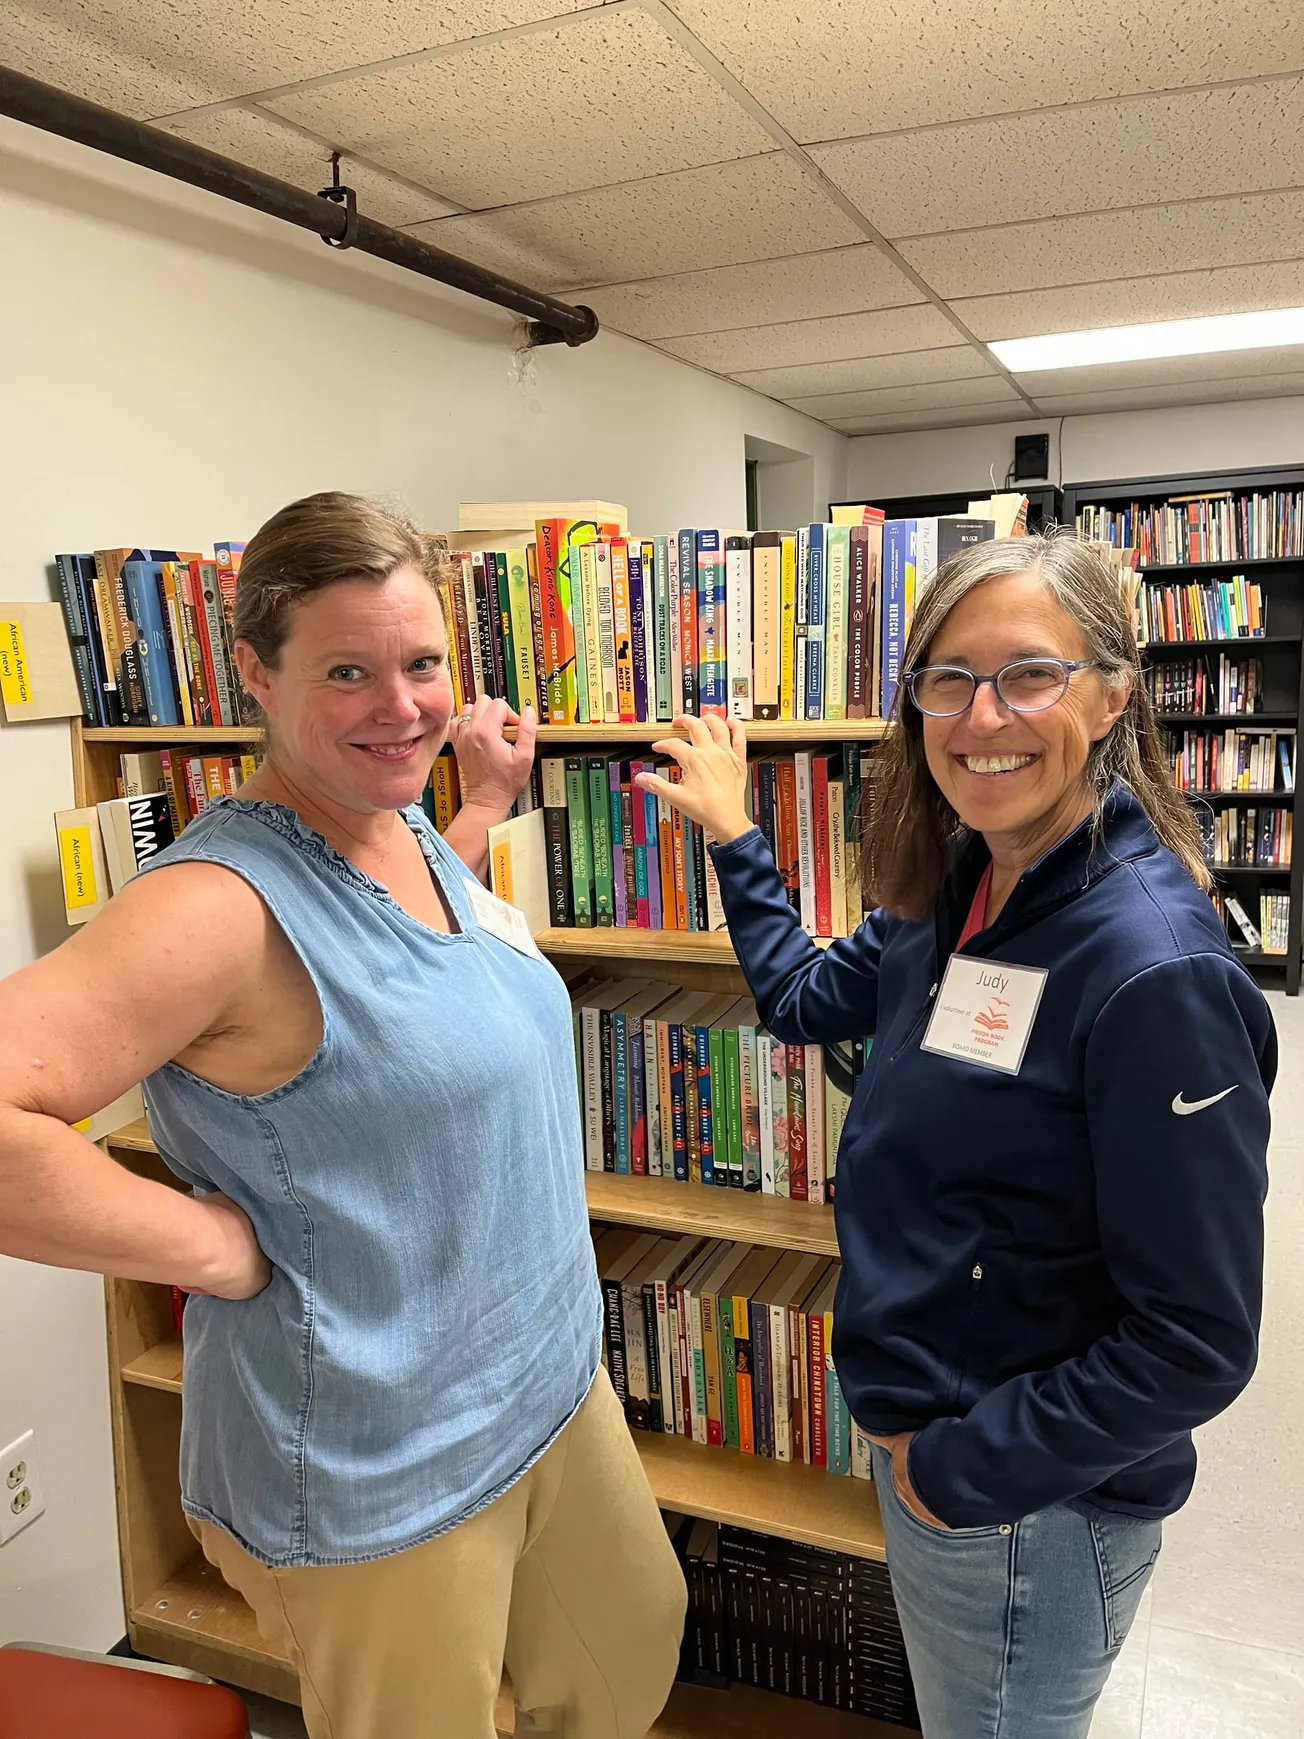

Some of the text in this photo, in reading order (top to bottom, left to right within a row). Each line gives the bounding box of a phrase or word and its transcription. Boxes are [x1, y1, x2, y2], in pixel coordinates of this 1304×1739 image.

[570, 550, 579, 578] WALKER
[612, 554, 625, 580] HELL
[855, 548, 863, 570] ALICE
[669, 560, 679, 616] The Color Purple
[705, 570, 715, 602] SHADOW
[832, 556, 841, 597] HOUSE
[855, 573, 863, 604] WALKER
[583, 560, 593, 627] Lesson Before Dying
[813, 593, 819, 604] MY
[114, 578, 137, 680] FREDERICK DOUGLASS
[502, 612, 510, 635] SULA
[598, 586, 614, 669] BELOVED TONI MORRISON
[615, 607, 628, 635] BOOK
[682, 536, 693, 692] REVIVAL SEASON MONICA WEST
[705, 604, 715, 623] KING
[832, 602, 841, 630] GIRL
[207, 606, 228, 704] PIECING ME TOGETHER
[470, 621, 482, 681] LINDEN HILLS
[483, 625, 493, 675] MORRISON
[532, 582, 543, 617] coming
[539, 667, 549, 707] america
[635, 597, 646, 682] TONI MORRISON
[659, 643, 666, 651] ON
[706, 639, 716, 662] MAAZA
[887, 603, 899, 682] REBECCA, NOT BECKY
[0, 650, 12, 677] (new)
[9, 623, 28, 702] African American
[519, 647, 529, 681] FAUSET
[549, 625, 563, 705] James McBride
[587, 638, 598, 687] GAINES
[854, 644, 862, 669] COLOR
[617, 667, 625, 691] MOTT
[706, 664, 716, 697] MENGISTE
[853, 671, 861, 698] PURPLE
[193, 772, 203, 791] The
[210, 766, 220, 791] THE
[436, 766, 446, 796] HOUSE
[831, 786, 839, 803] Paton
[439, 800, 447, 812] OF
[783, 766, 793, 836] Half Yellow Sun
[799, 797, 807, 815] JOLLOF
[169, 806, 181, 833] MADNESS
[800, 816, 808, 828] RICE
[800, 829, 808, 838] AND
[576, 819, 586, 879] BURIED BENEATH
[598, 817, 607, 877] BURIED BENEATH
[637, 847, 645, 870] ARROW
[800, 839, 809, 855] OTHER
[71, 838, 86, 897] African (new)
[499, 855, 507, 891] African
[552, 823, 565, 911] THE POWER OF ONE
[675, 837, 684, 892] MY STORY
[707, 864, 717, 896] ADICHIE
[801, 856, 810, 888] REVOLUTIONS
[833, 854, 841, 879] Country
[976, 970, 1010, 993] Judy
[602, 1025, 611, 1052] Magical
[645, 1024, 654, 1064] HA JIN
[742, 1033, 750, 1051] THE
[952, 1042, 993, 1059] BOARD MEMBER
[971, 1028, 1005, 1041] PRISON BOOK
[974, 1037, 999, 1047] PROGRAM
[587, 1032, 595, 1071] INVISIBLE
[615, 1019, 626, 1090] ASYMMETRY
[630, 1039, 641, 1069] Jasmine
[588, 1071, 596, 1103] VALLEY
[602, 1054, 611, 1091] Language
[671, 1032, 682, 1130] EDINBURGH ALEXANDER
[699, 1034, 708, 1134] EDINBURGH ALEXANDER
[743, 1055, 752, 1097] PICTURE
[590, 1116, 596, 1125] SU
[604, 1099, 612, 1125] Others
[745, 1099, 753, 1126] BRIDE
[789, 1076, 804, 1151] The Mountains Sing
[656, 1283, 666, 1314] NO-NO BOY
[702, 1298, 713, 1333] ELSEWHERE
[607, 1288, 626, 1403] CHANG-RAE LEE NATIVE SPEAKER
[811, 1320, 821, 1361] INTERIOR
[812, 1365, 822, 1416] CHINATOWN
